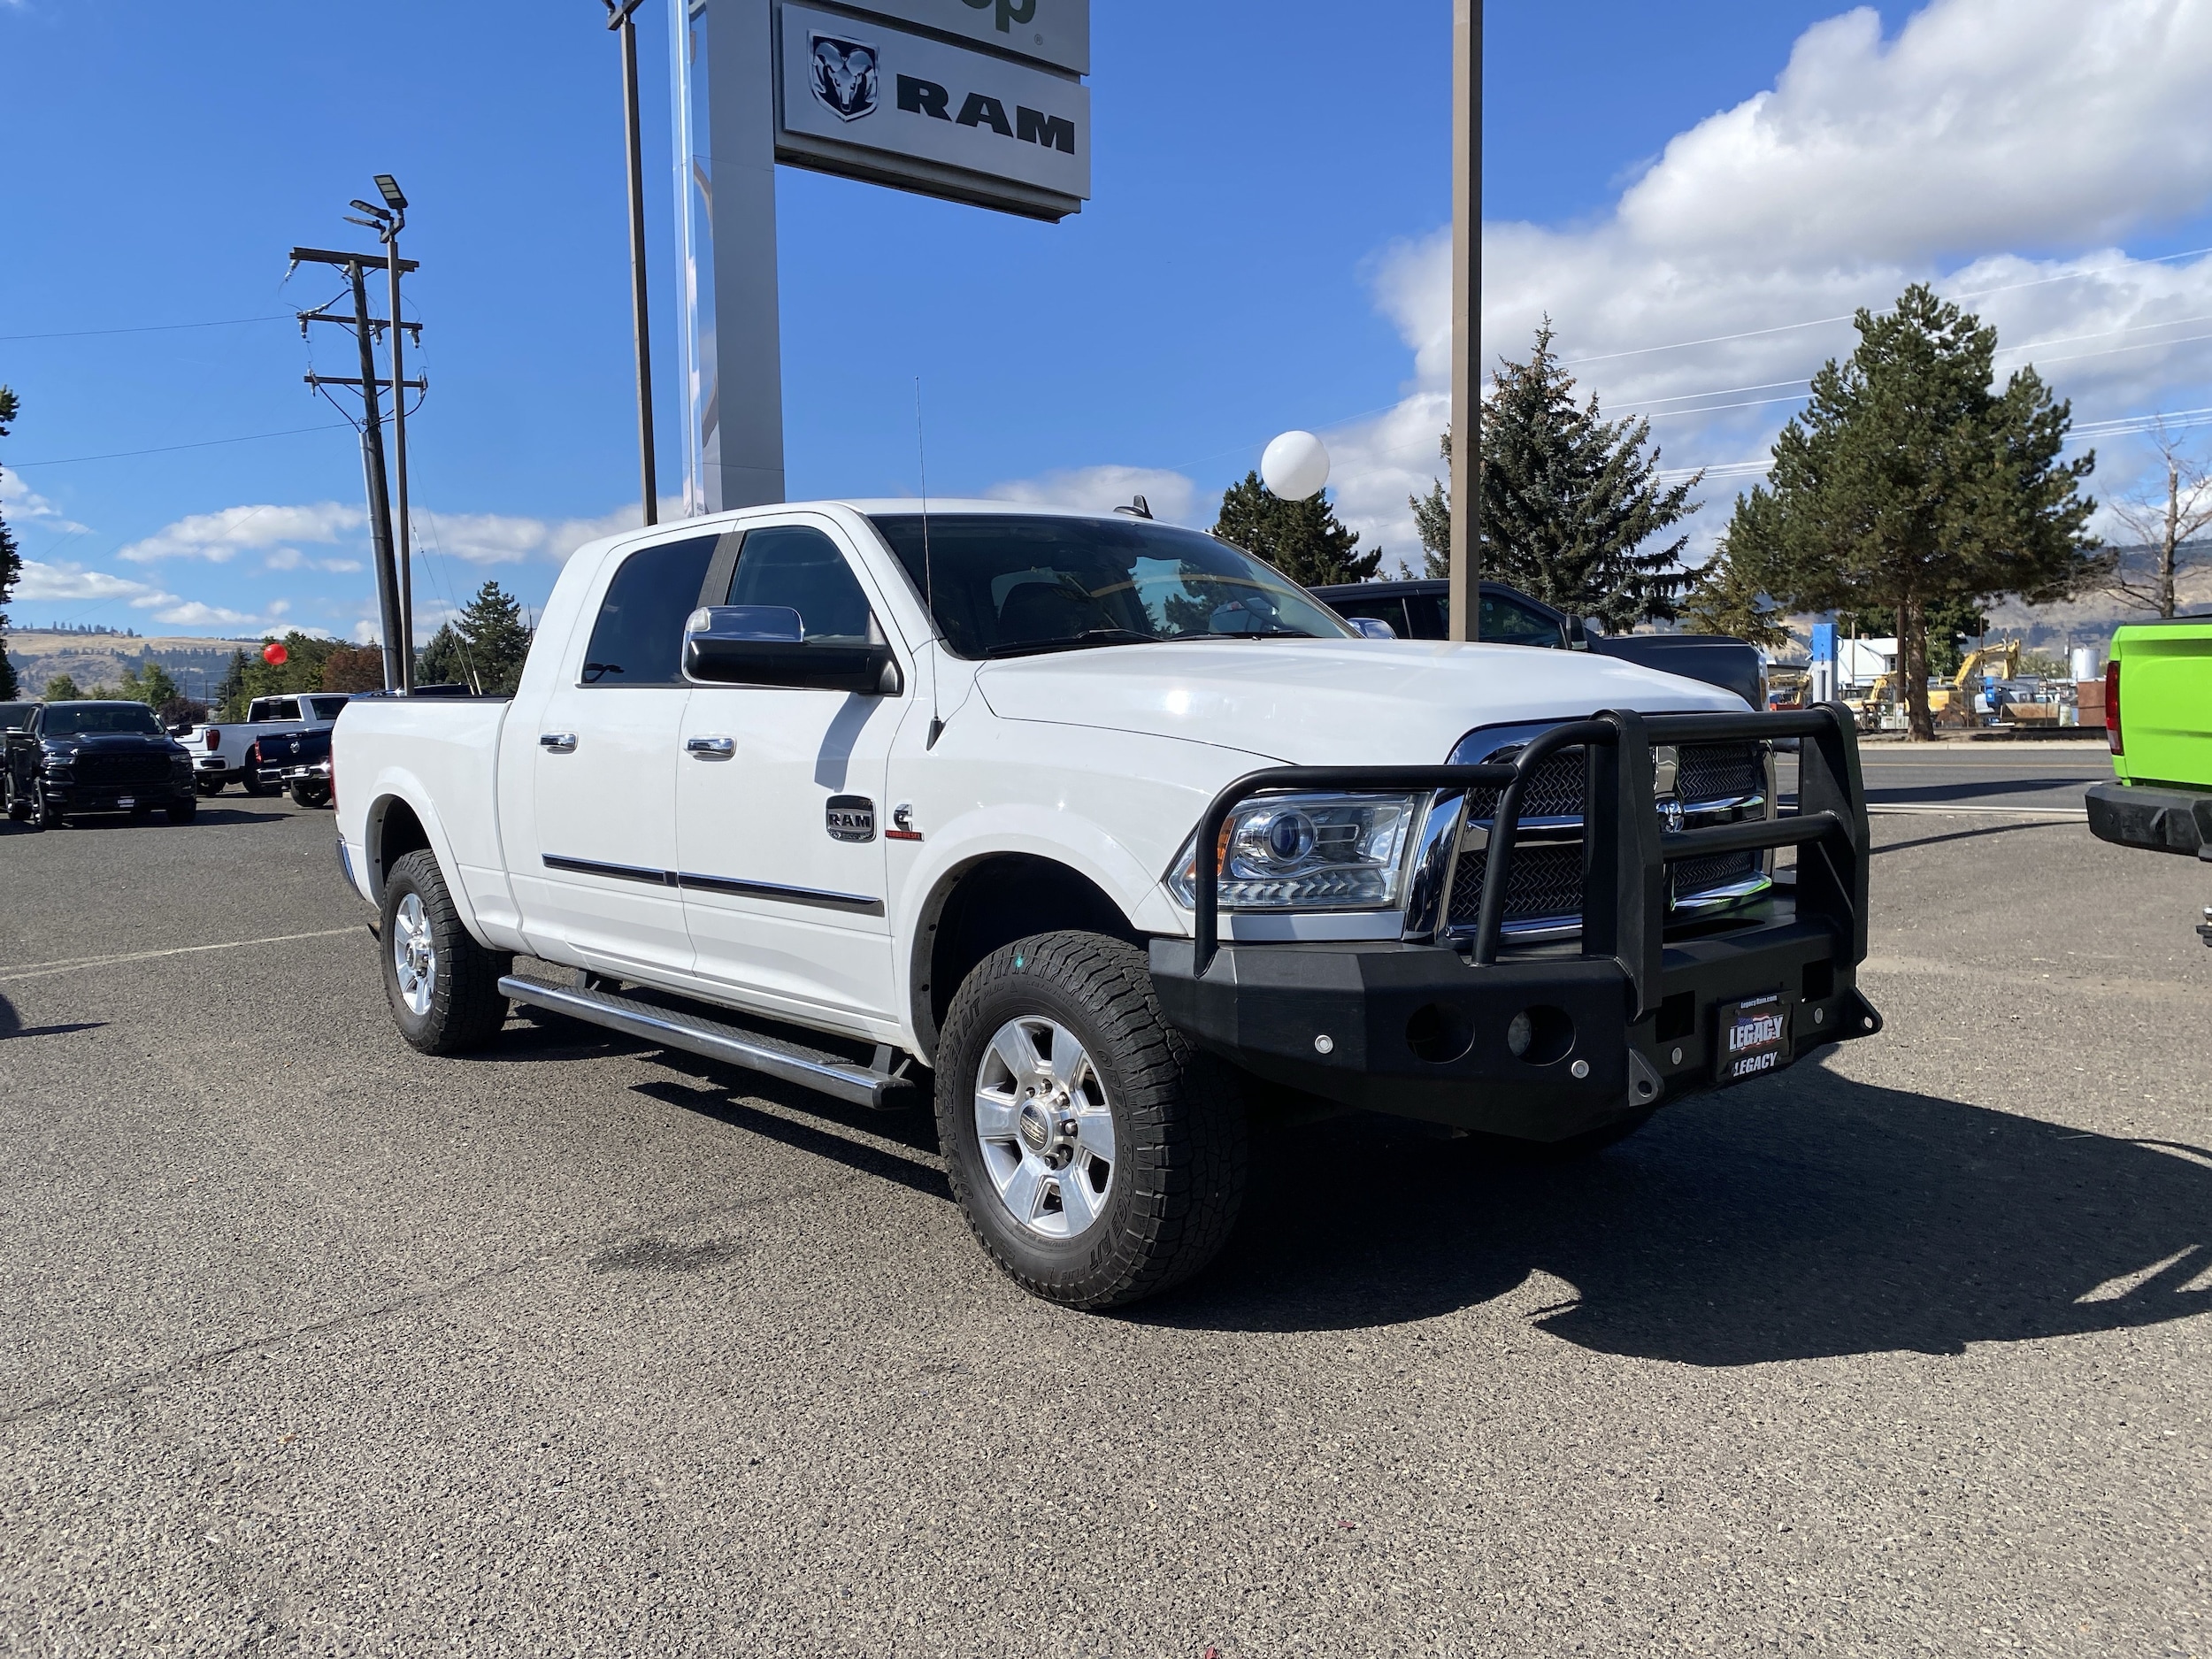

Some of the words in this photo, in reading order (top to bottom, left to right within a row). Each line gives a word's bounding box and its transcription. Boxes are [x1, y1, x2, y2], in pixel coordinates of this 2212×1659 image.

[896, 73, 1075, 155] RAM
[828, 813, 872, 828] RAM
[1740, 995, 1778, 1009] LegacyRam.com
[1729, 1016, 1784, 1050] LEGACY
[1733, 1051, 1778, 1077] LEGACY
[1097, 1049, 1132, 1132] OPEN
[1111, 1133, 1134, 1239] RANGE
[1089, 1230, 1112, 1271] A/T
